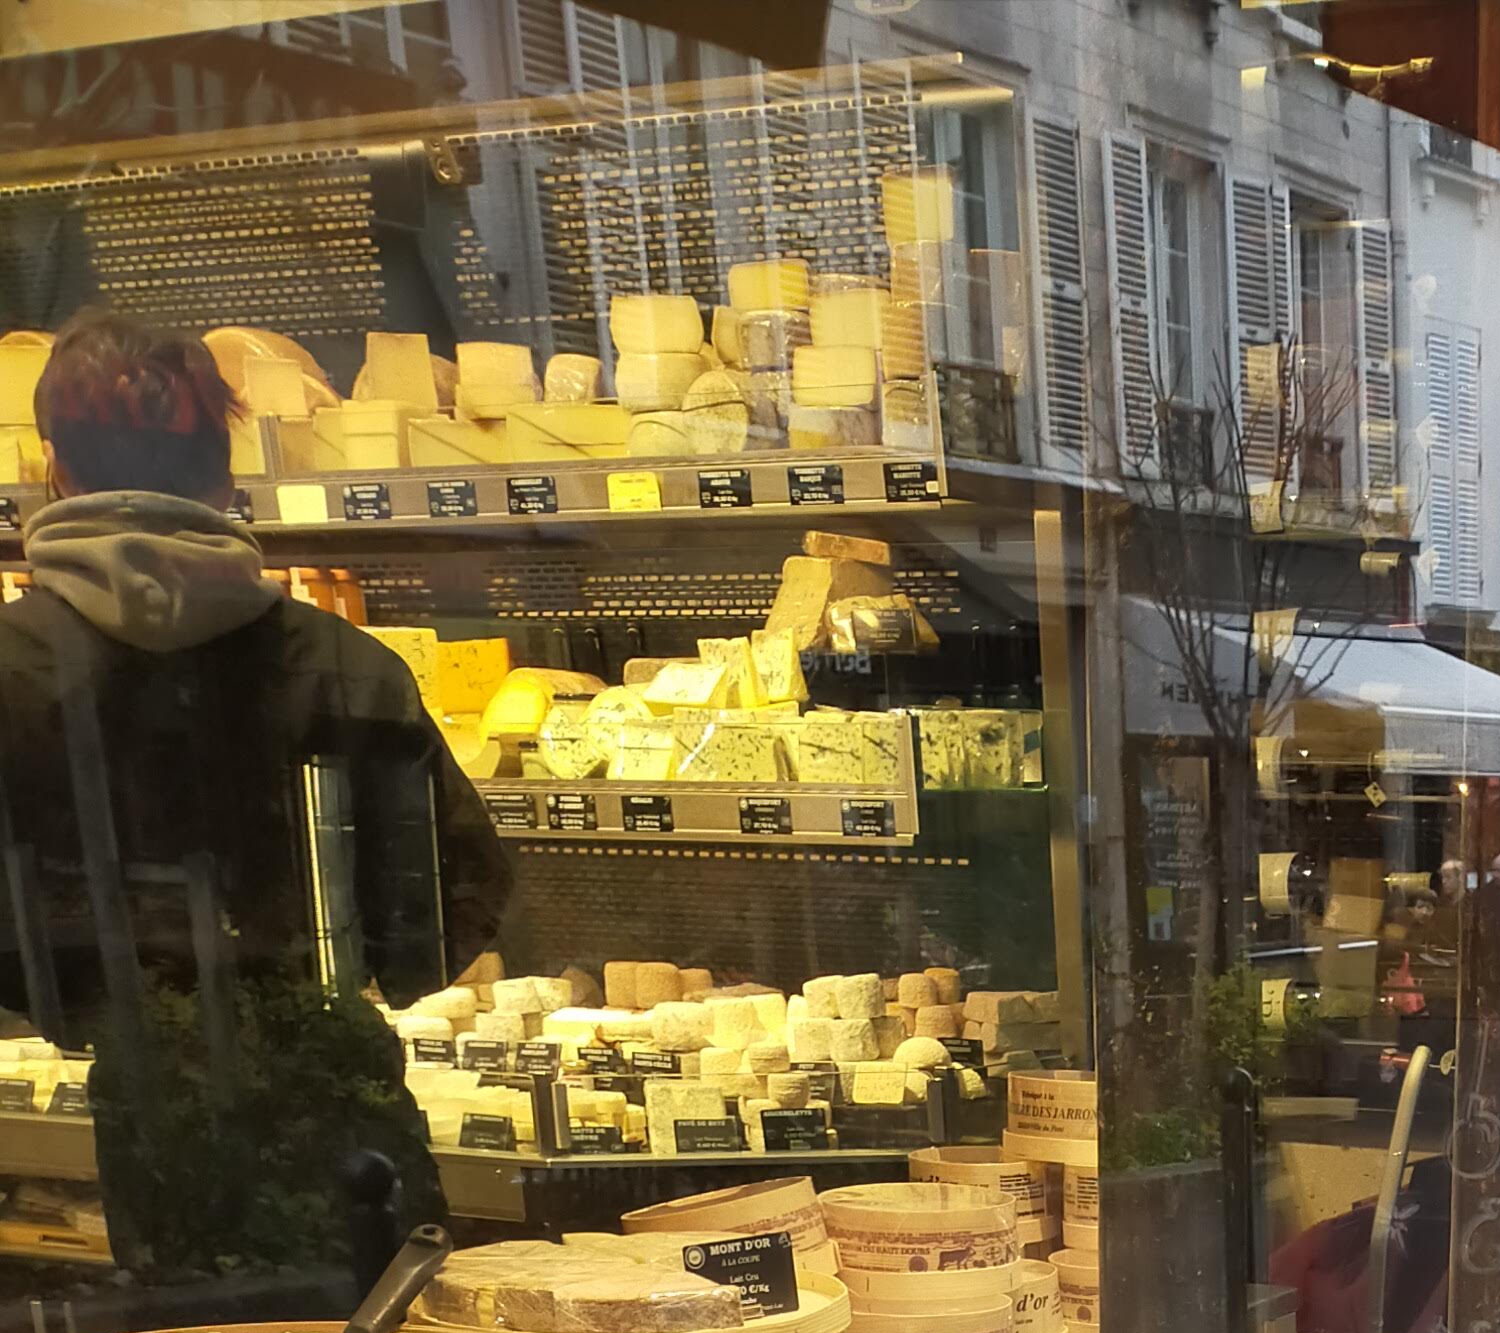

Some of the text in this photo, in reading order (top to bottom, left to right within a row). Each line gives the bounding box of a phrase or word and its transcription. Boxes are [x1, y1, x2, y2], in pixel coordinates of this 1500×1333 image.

[709, 1238, 771, 1256] MONT D'OR
[1016, 1293, 1049, 1314] d'or
